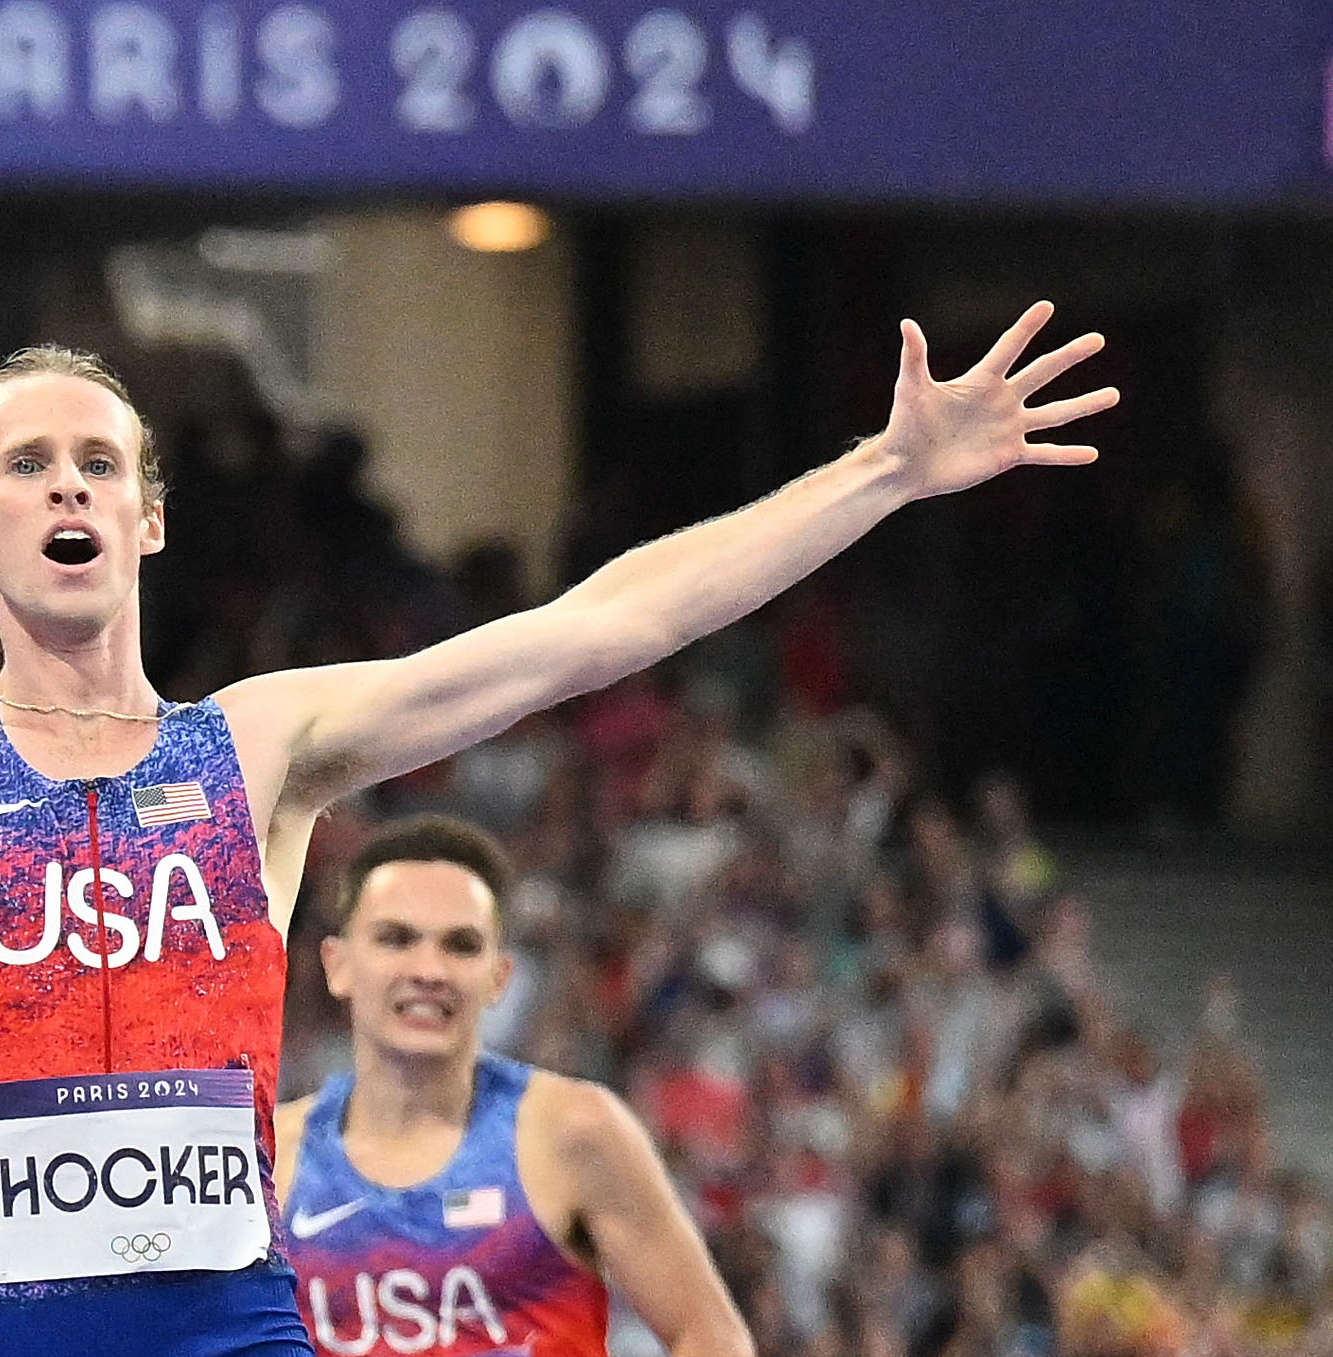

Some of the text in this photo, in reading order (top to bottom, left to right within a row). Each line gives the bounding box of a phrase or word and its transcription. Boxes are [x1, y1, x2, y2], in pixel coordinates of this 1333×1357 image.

[391, 8, 815, 134] 2024
[57, 1080, 199, 1105] PARIS 2024
[0, 1145, 255, 1217] HOCKER
[308, 1264, 507, 1357] USA
